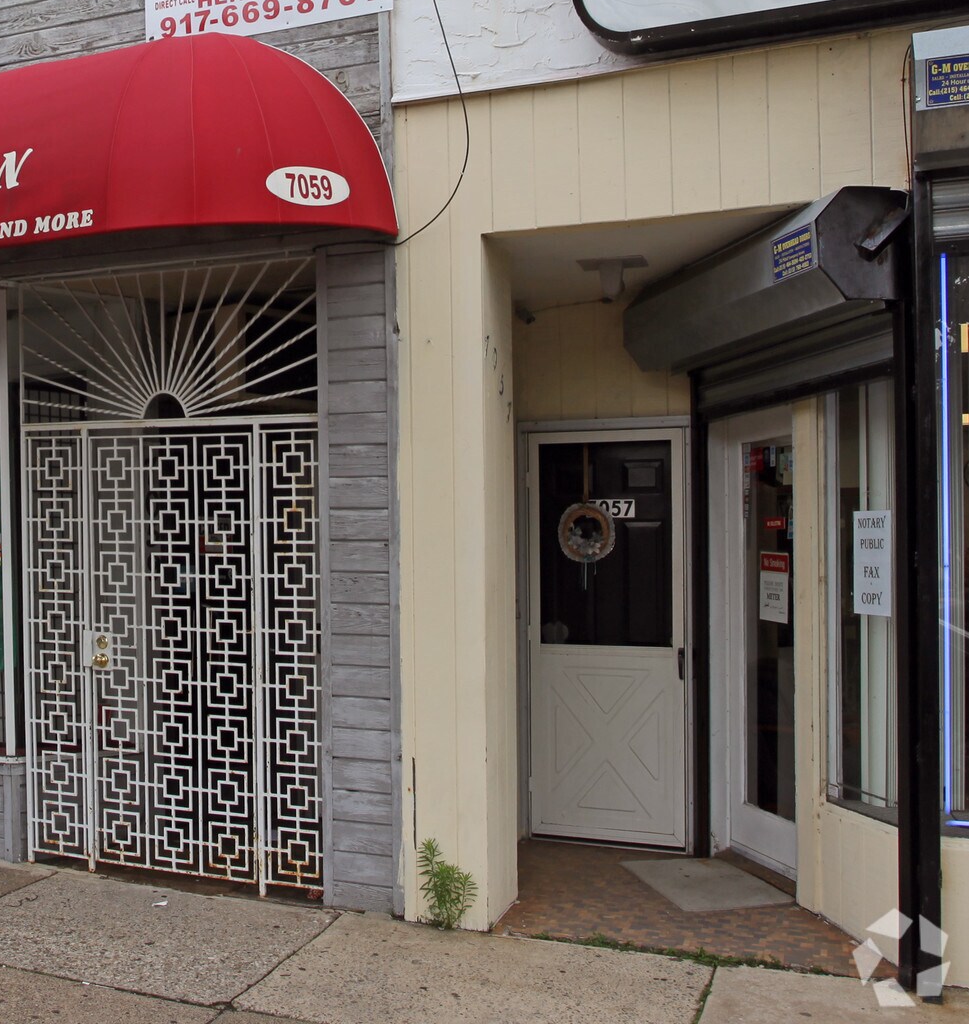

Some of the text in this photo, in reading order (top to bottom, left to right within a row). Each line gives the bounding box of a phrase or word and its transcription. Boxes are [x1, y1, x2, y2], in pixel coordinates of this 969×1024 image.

[932, 63, 951, 74] G-M
[285, 173, 333, 200] 7059
[33, 209, 94, 234] MORE
[589, 500, 634, 517] 057
[858, 515, 886, 529] NOTARY
[860, 538, 884, 549] PUBLIC
[864, 566, 880, 578] FAX
[861, 591, 883, 606] COPY
